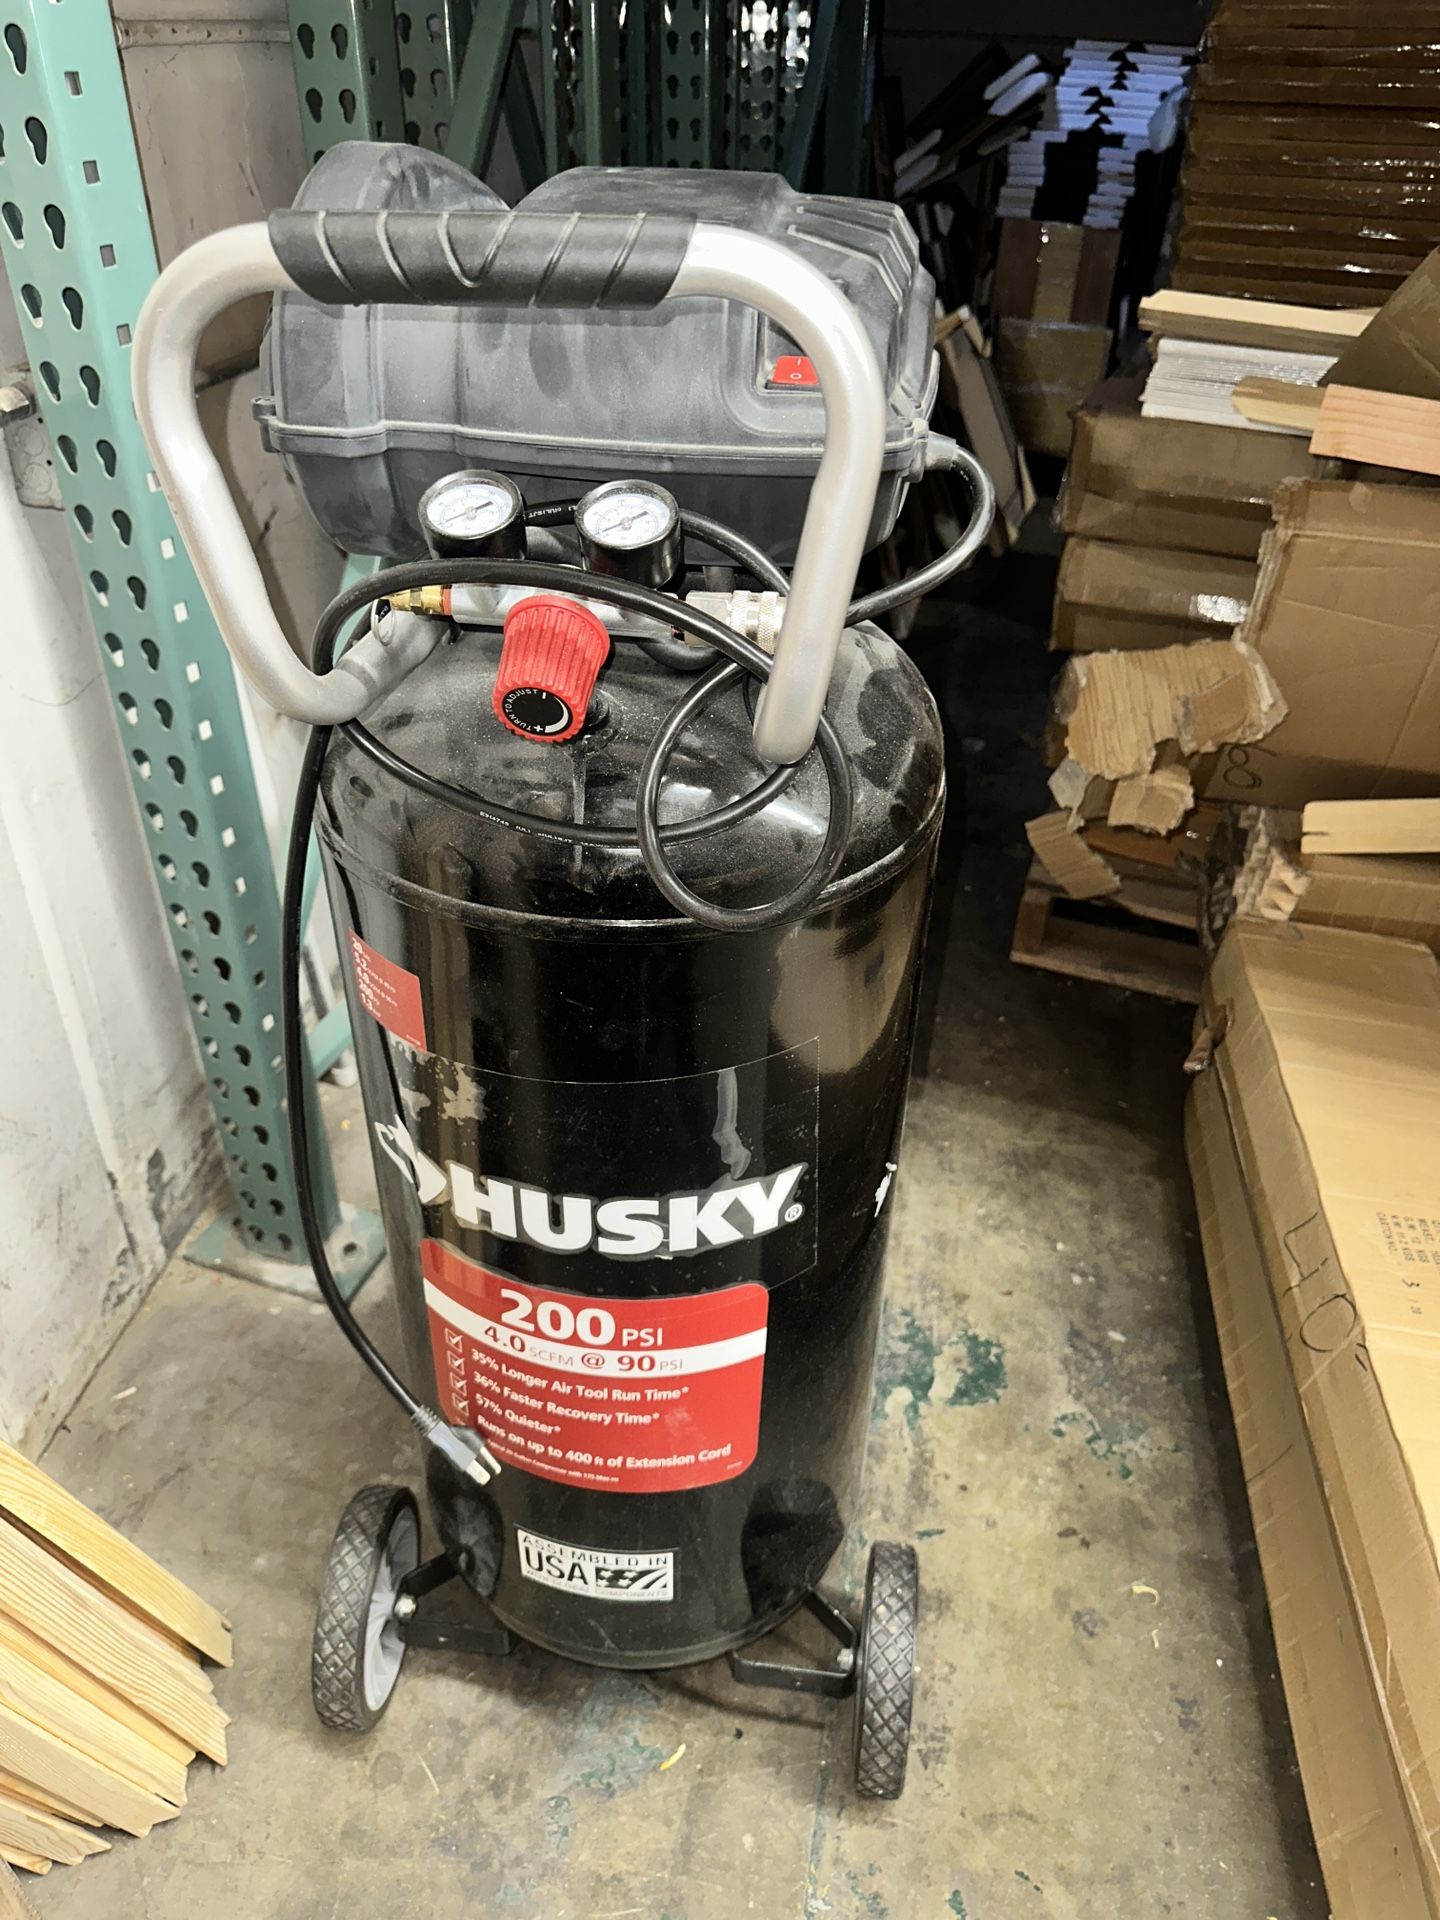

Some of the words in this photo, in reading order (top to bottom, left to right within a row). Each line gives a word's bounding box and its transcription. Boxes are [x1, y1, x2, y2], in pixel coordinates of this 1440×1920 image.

[505, 703, 512, 713] TO
[507, 689, 538, 704] ADJUST
[509, 714, 532, 731] TURN
[500, 1288, 616, 1346] 200
[622, 1327, 663, 1348] PSI
[484, 1325, 526, 1354] 4.0
[528, 1346, 574, 1367] SCFM
[581, 1353, 606, 1369] @
[617, 1355, 656, 1373] 90
[659, 1359, 684, 1371] PSI
[471, 1348, 500, 1372] 35%
[501, 1363, 549, 1389] Longer
[551, 1380, 573, 1396] Air
[575, 1384, 608, 1400] Tool
[611, 1388, 641, 1402] Run
[473, 1371, 501, 1395] 36%
[503, 1386, 544, 1411] Faster
[546, 1401, 613, 1426] Recovery
[475, 1393, 503, 1416] 57%
[477, 1414, 506, 1438] Runs
[507, 1432, 525, 1448] on
[527, 1440, 545, 1456] up
[547, 1445, 563, 1459] to
[565, 1450, 593, 1466] 400
[607, 1455, 624, 1468] of
[625, 1453, 696, 1469] Extension
[698, 1443, 732, 1462] Cord
[523, 1535, 639, 1567] ASSEMBLED
[648, 1555, 667, 1566] IN
[525, 1546, 589, 1586] USA
